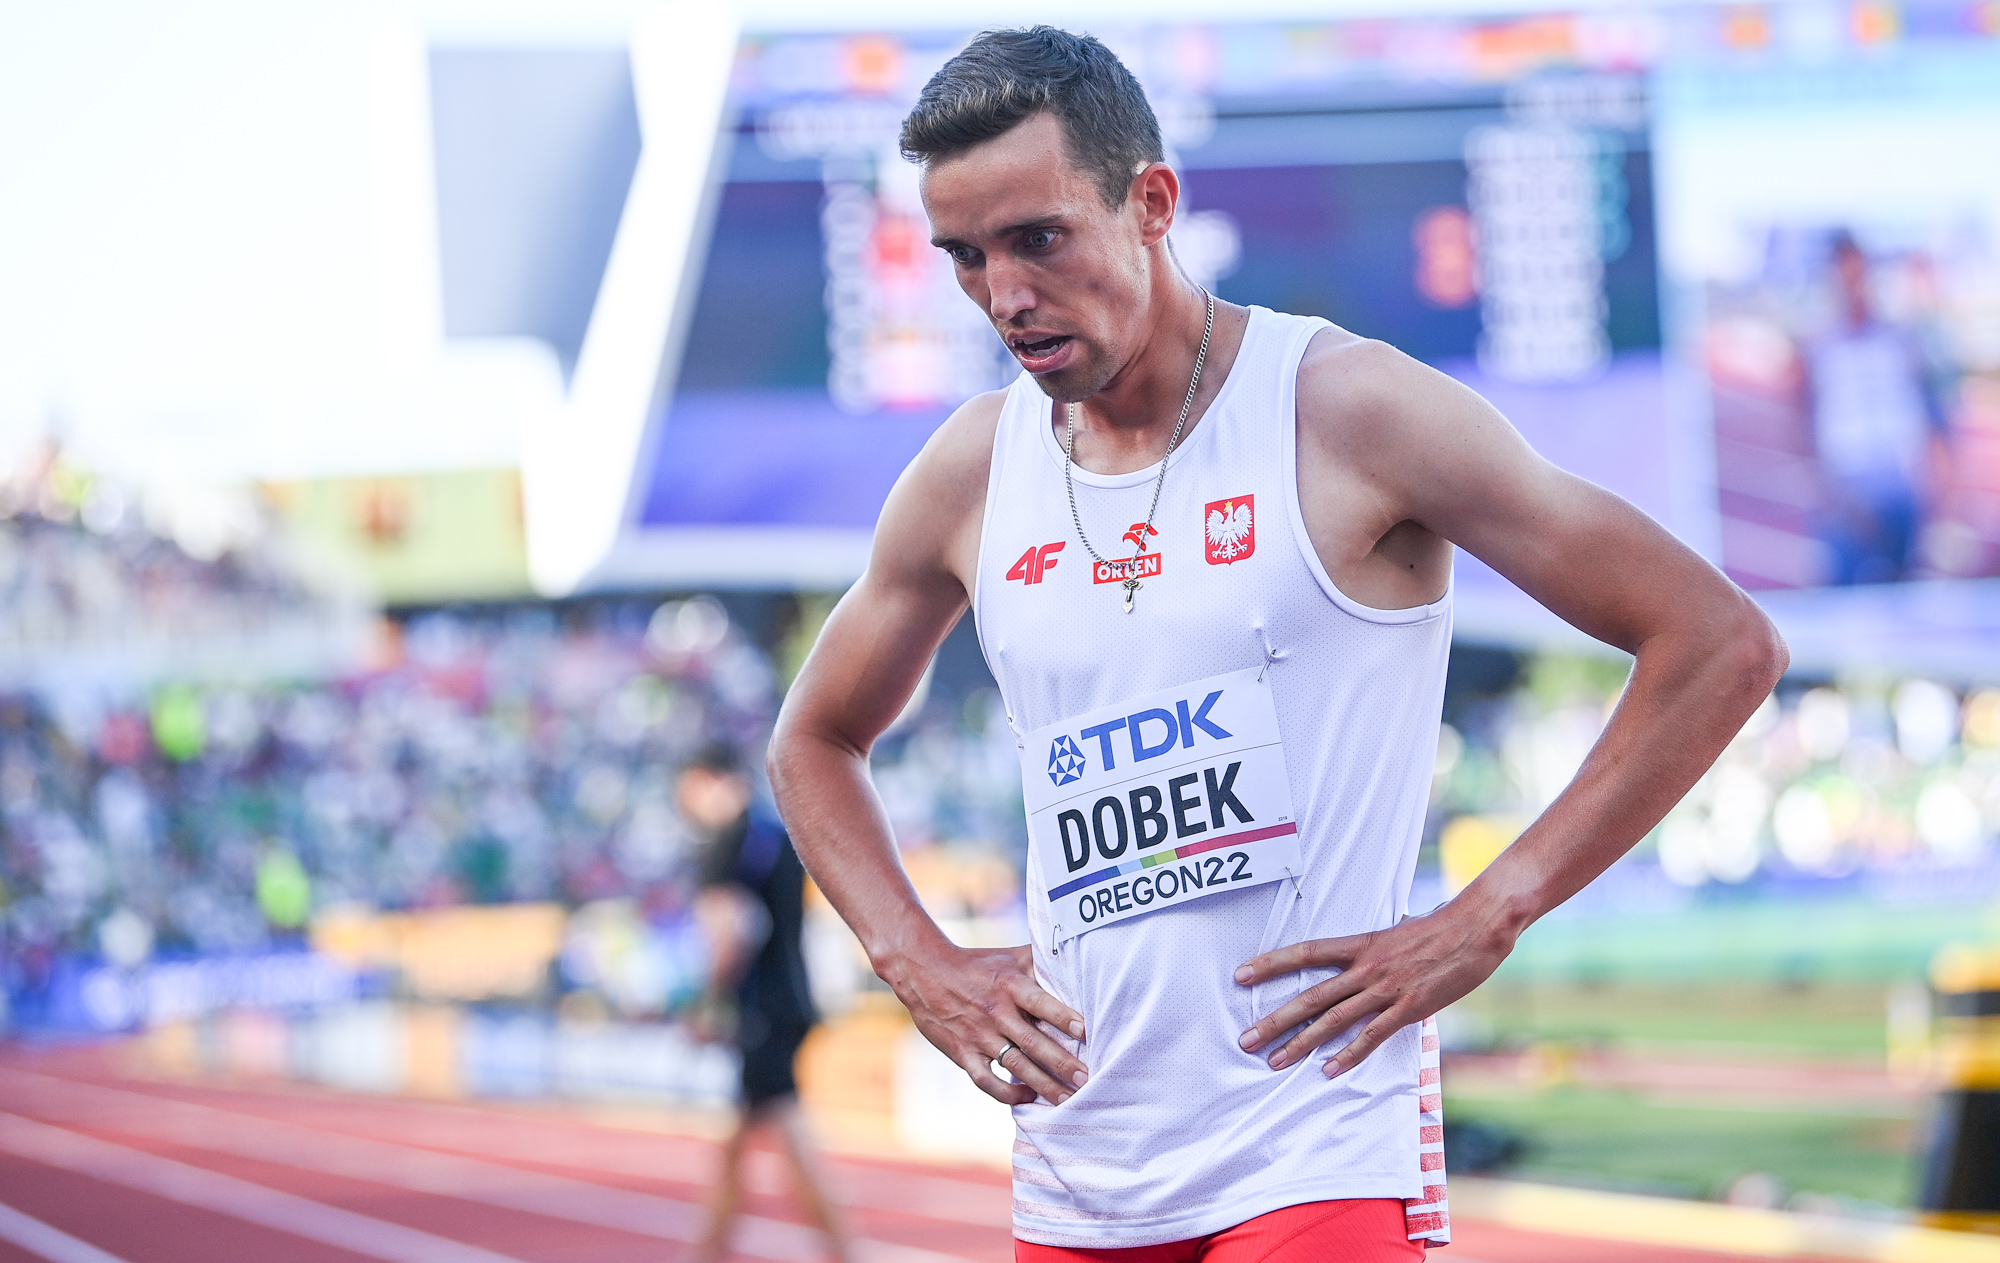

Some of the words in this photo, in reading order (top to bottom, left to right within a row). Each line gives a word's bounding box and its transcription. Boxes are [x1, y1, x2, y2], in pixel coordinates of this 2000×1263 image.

[1006, 541, 1066, 585] 4F
[1080, 690, 1233, 771] TDK
[1057, 761, 1255, 873] DOBEK
[1078, 852, 1253, 923] OREGON22
